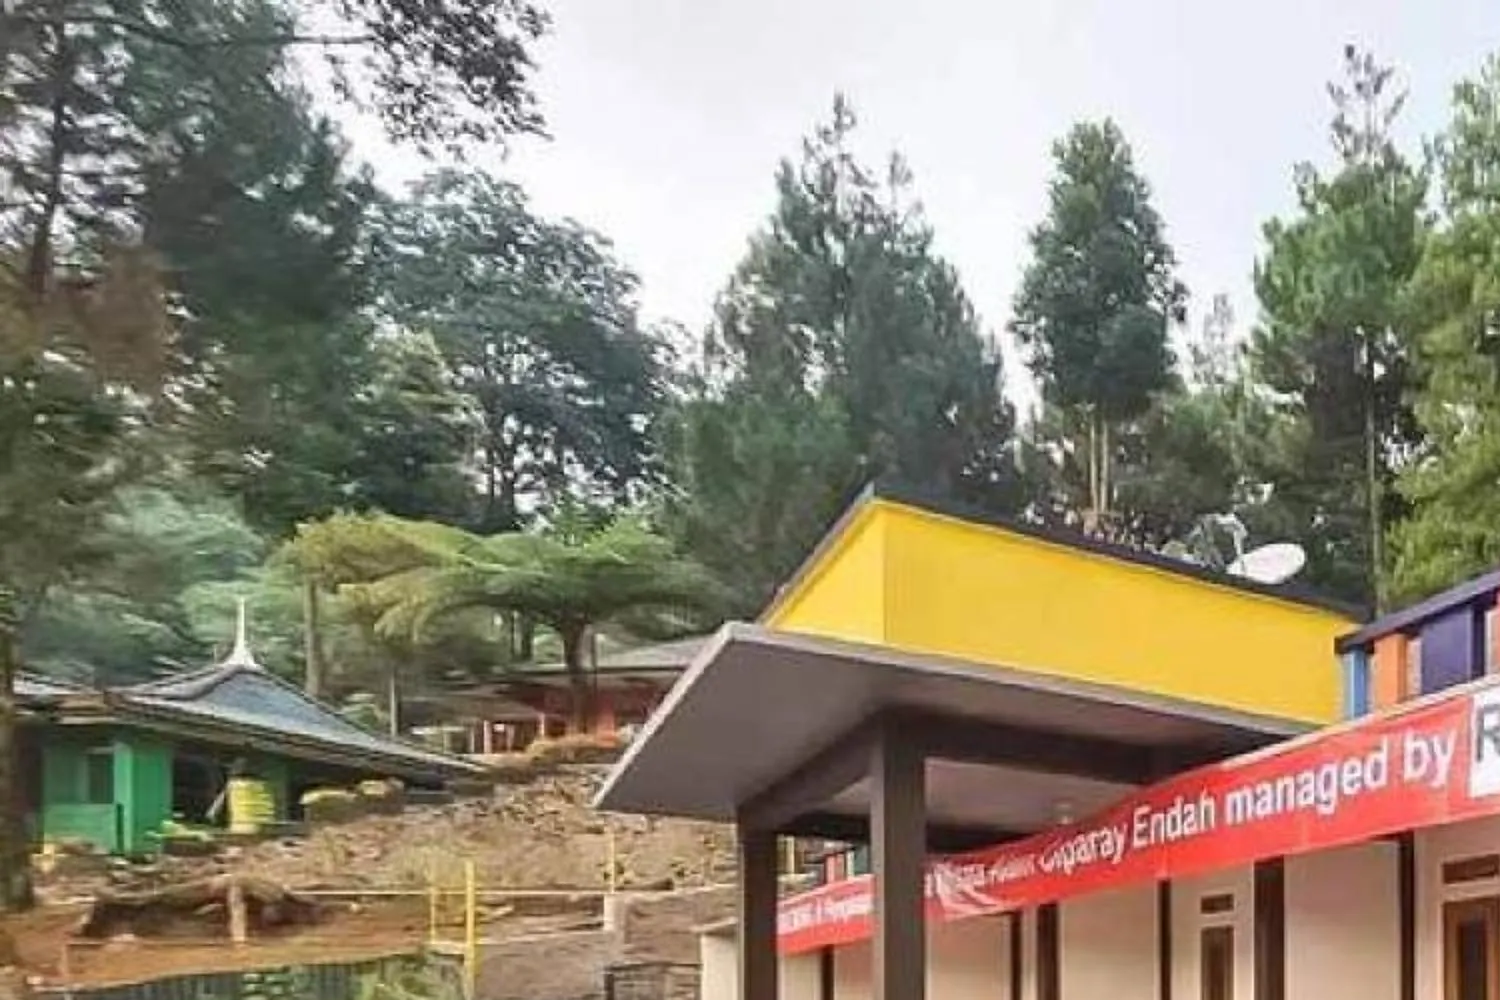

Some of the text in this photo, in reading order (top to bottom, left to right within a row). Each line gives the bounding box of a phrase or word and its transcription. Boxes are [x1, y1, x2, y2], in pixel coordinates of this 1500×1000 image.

[1133, 789, 1214, 848] Endah
[1226, 743, 1394, 826] managed
[1403, 730, 1457, 788] by
